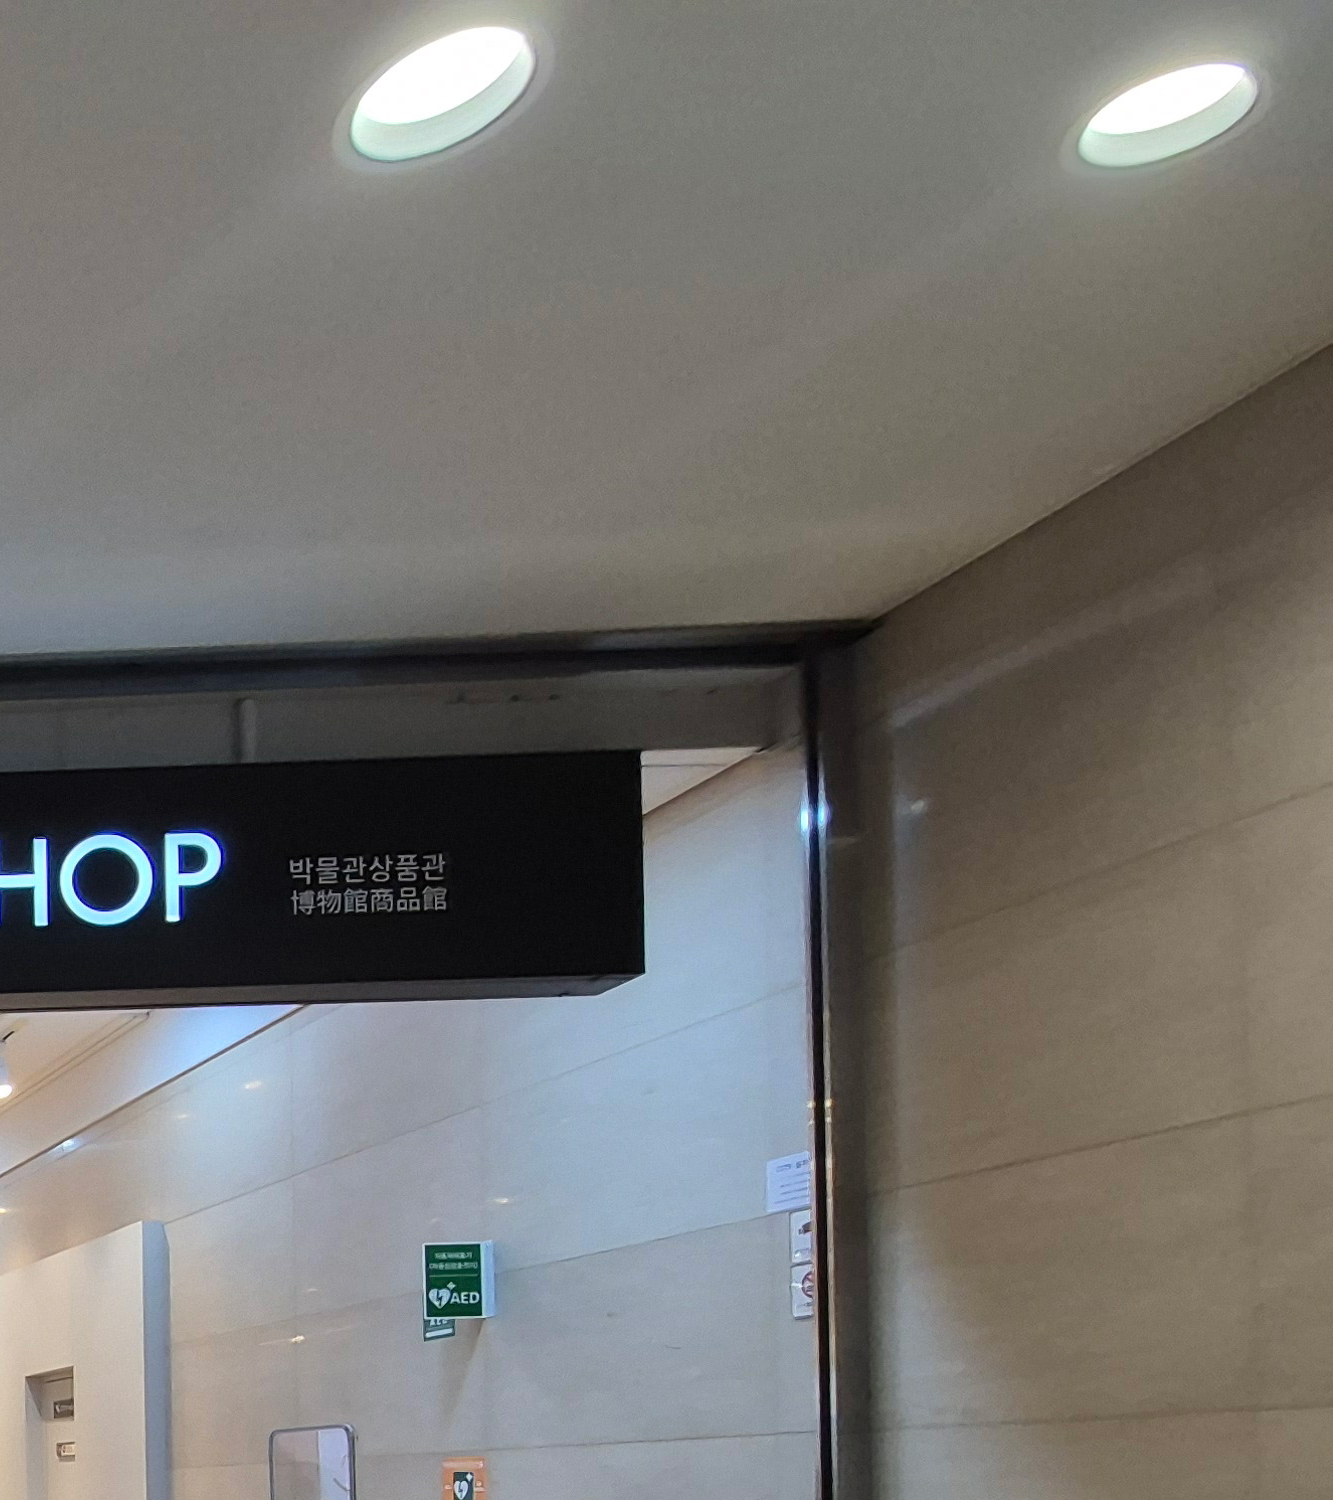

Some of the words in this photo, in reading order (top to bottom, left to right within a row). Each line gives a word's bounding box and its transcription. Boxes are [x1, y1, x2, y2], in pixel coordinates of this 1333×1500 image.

[289, 853, 446, 885] 박물관상품관
[290, 885, 448, 915] 博物館商品館
[450, 1291, 480, 1304] AED
